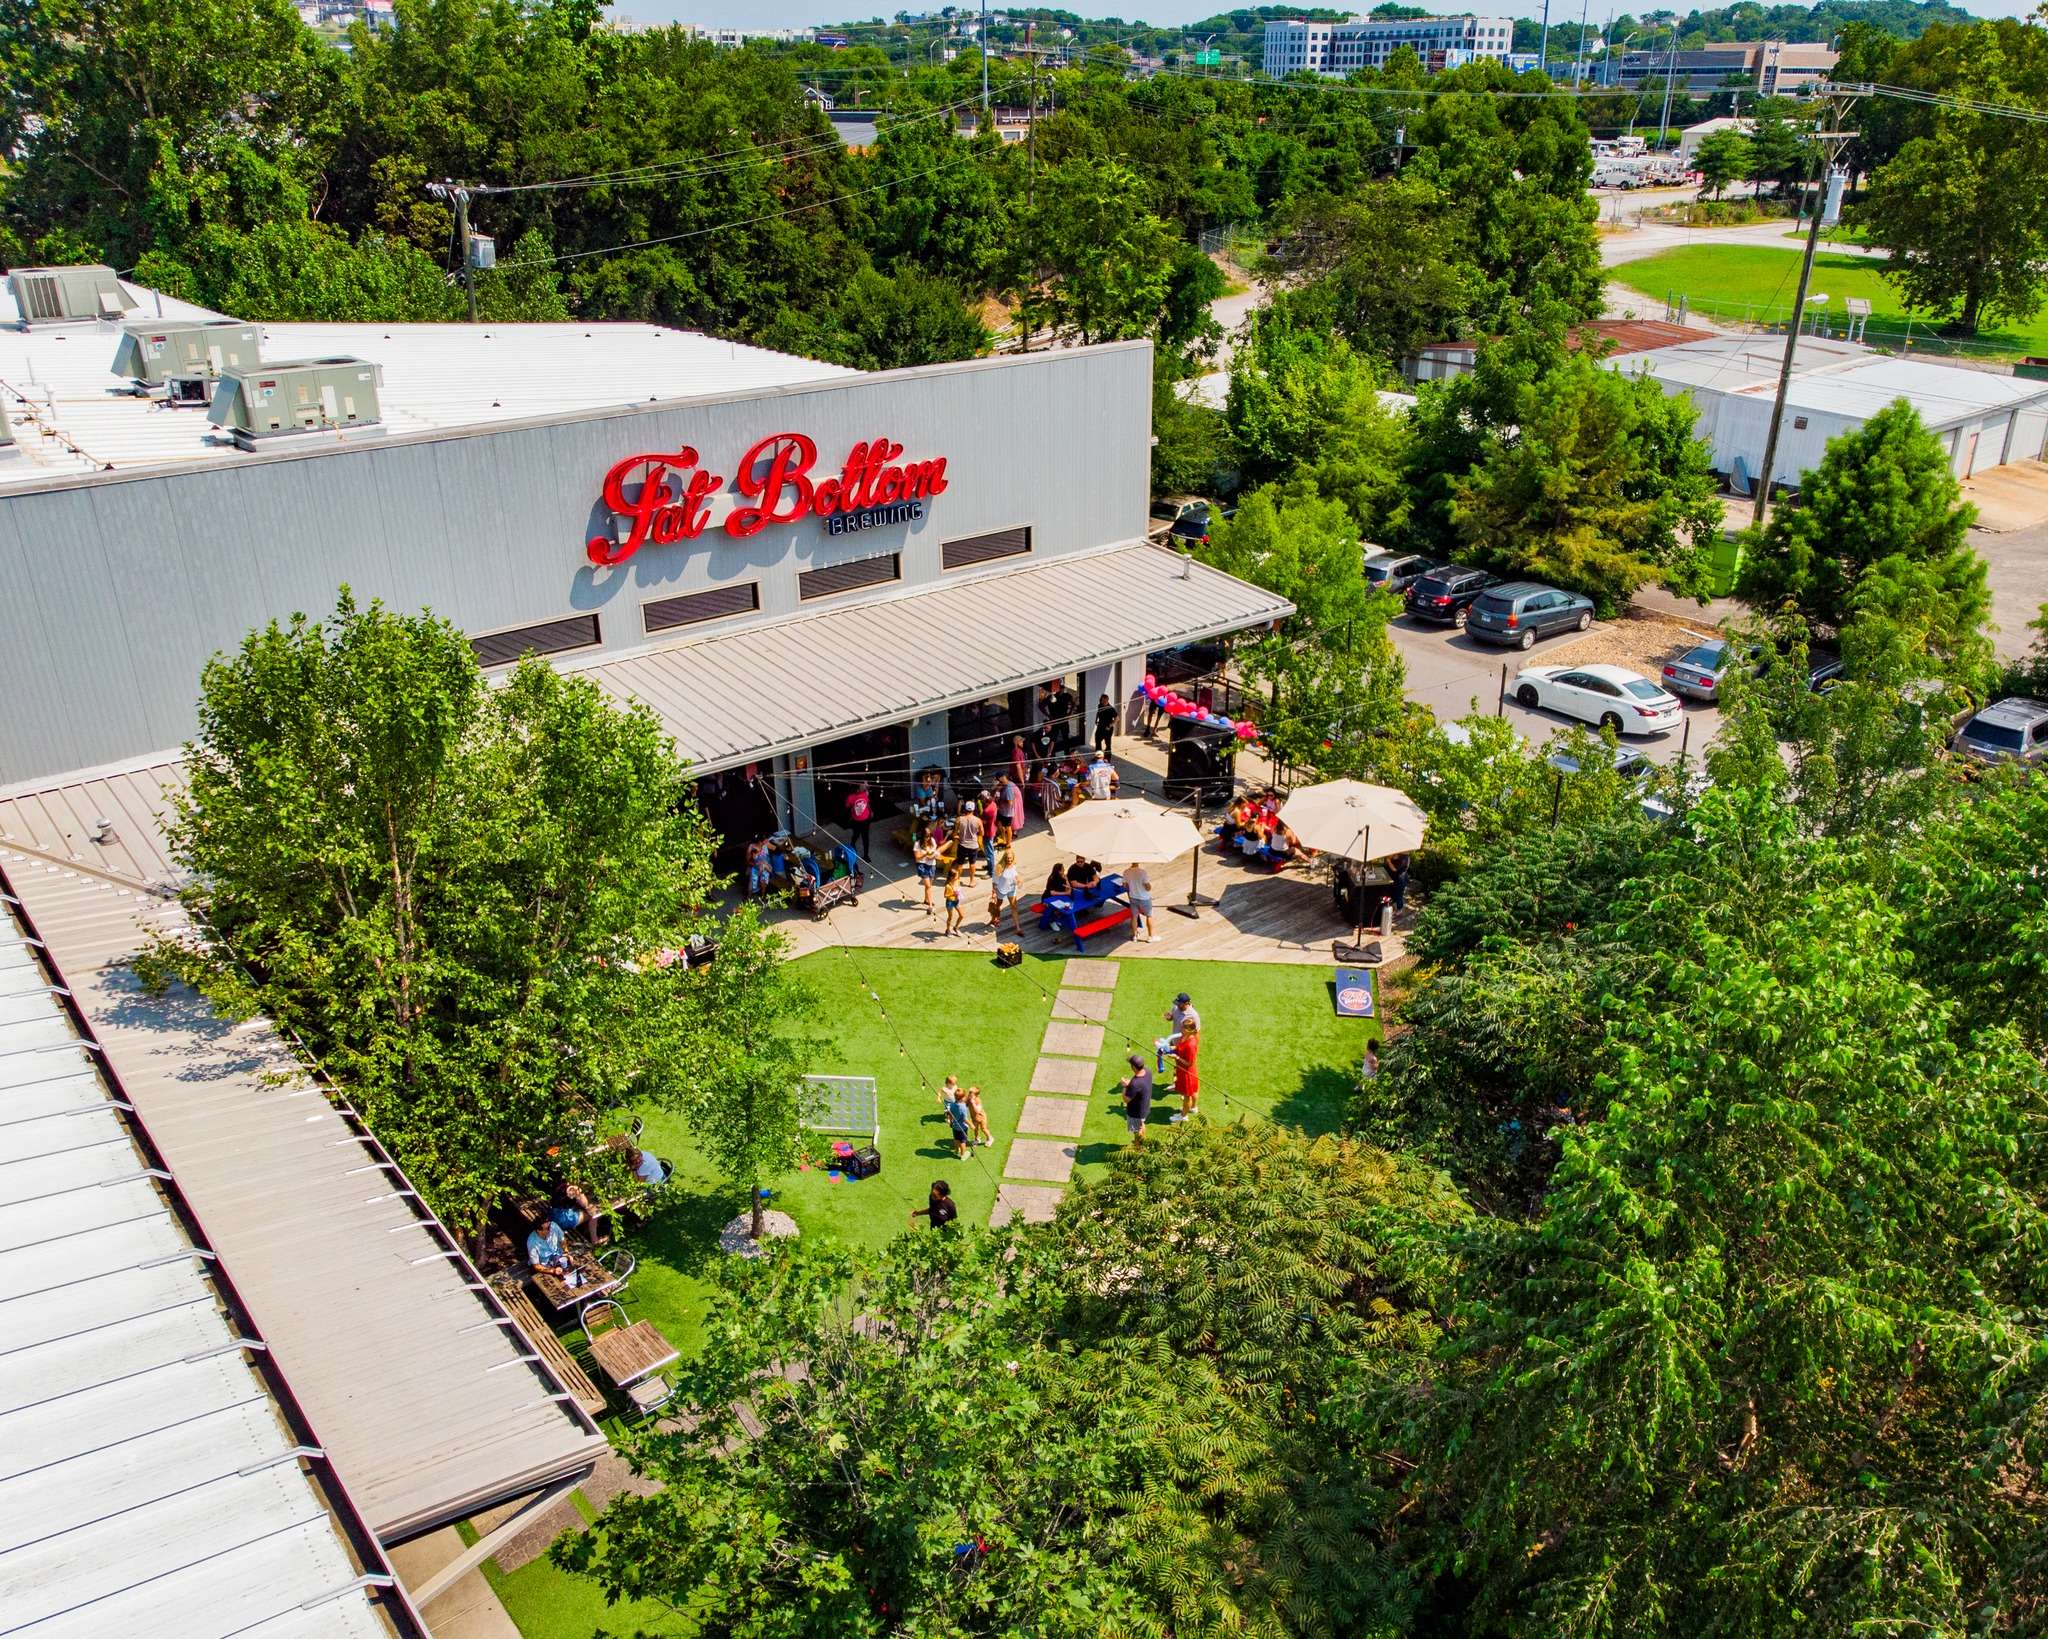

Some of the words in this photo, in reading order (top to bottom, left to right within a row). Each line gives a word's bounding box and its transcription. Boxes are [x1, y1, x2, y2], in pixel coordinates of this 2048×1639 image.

[586, 445, 724, 566] Fat
[724, 432, 949, 538] Bottom
[829, 502, 924, 536] BREWING
